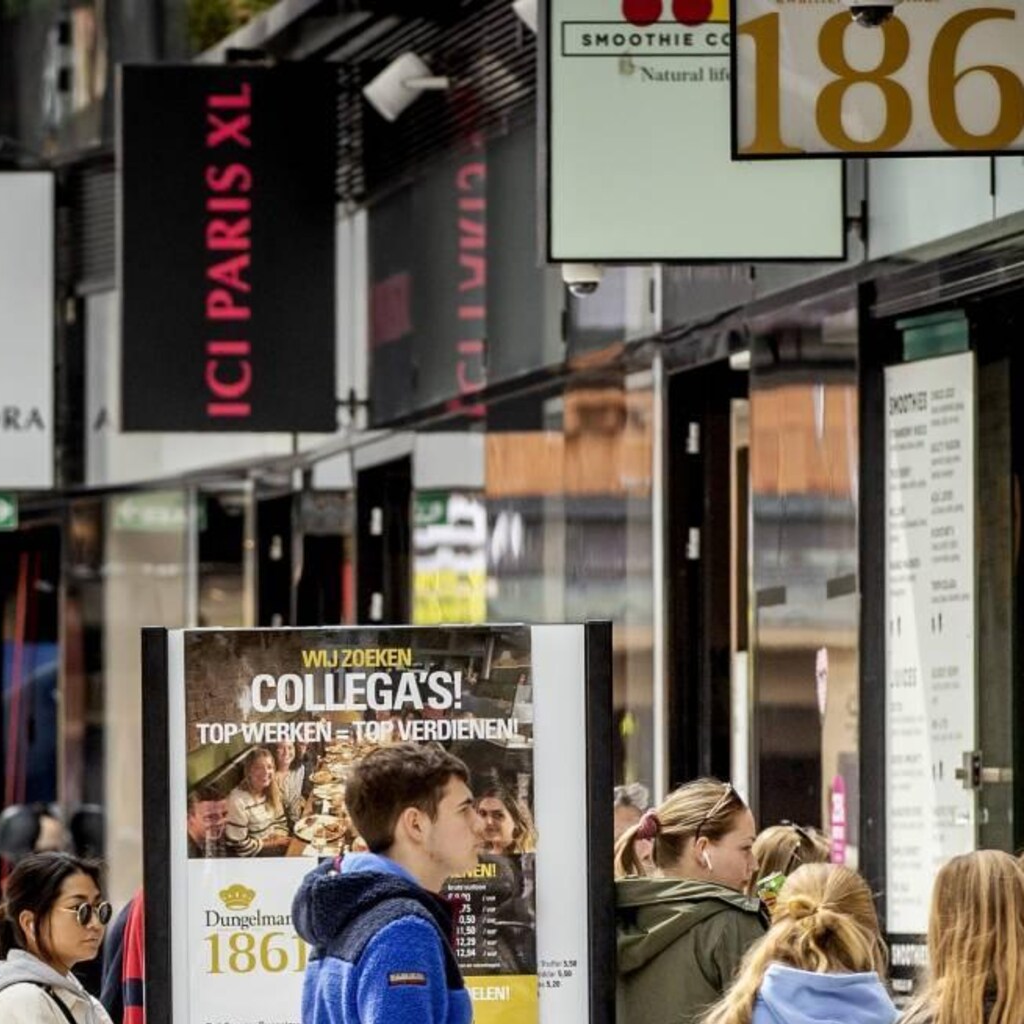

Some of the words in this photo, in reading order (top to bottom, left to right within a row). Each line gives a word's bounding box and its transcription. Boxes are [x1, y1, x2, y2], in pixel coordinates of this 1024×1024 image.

[581, 33, 694, 46] SMOOTHIE
[640, 66, 704, 82] Natural
[205, 82, 252, 147] XL
[205, 162, 252, 319] PARIS
[205, 341, 252, 416] ICI
[302, 649, 339, 667] WIJ
[341, 648, 412, 667] ZOEKEN
[251, 671, 462, 713] COLLEGA'S!
[196, 723, 237, 746] TOP
[241, 721, 332, 745] WERKEN
[352, 720, 395, 744] TOP
[399, 718, 519, 743] VERDIENEN!
[204, 932, 307, 974] 1861
